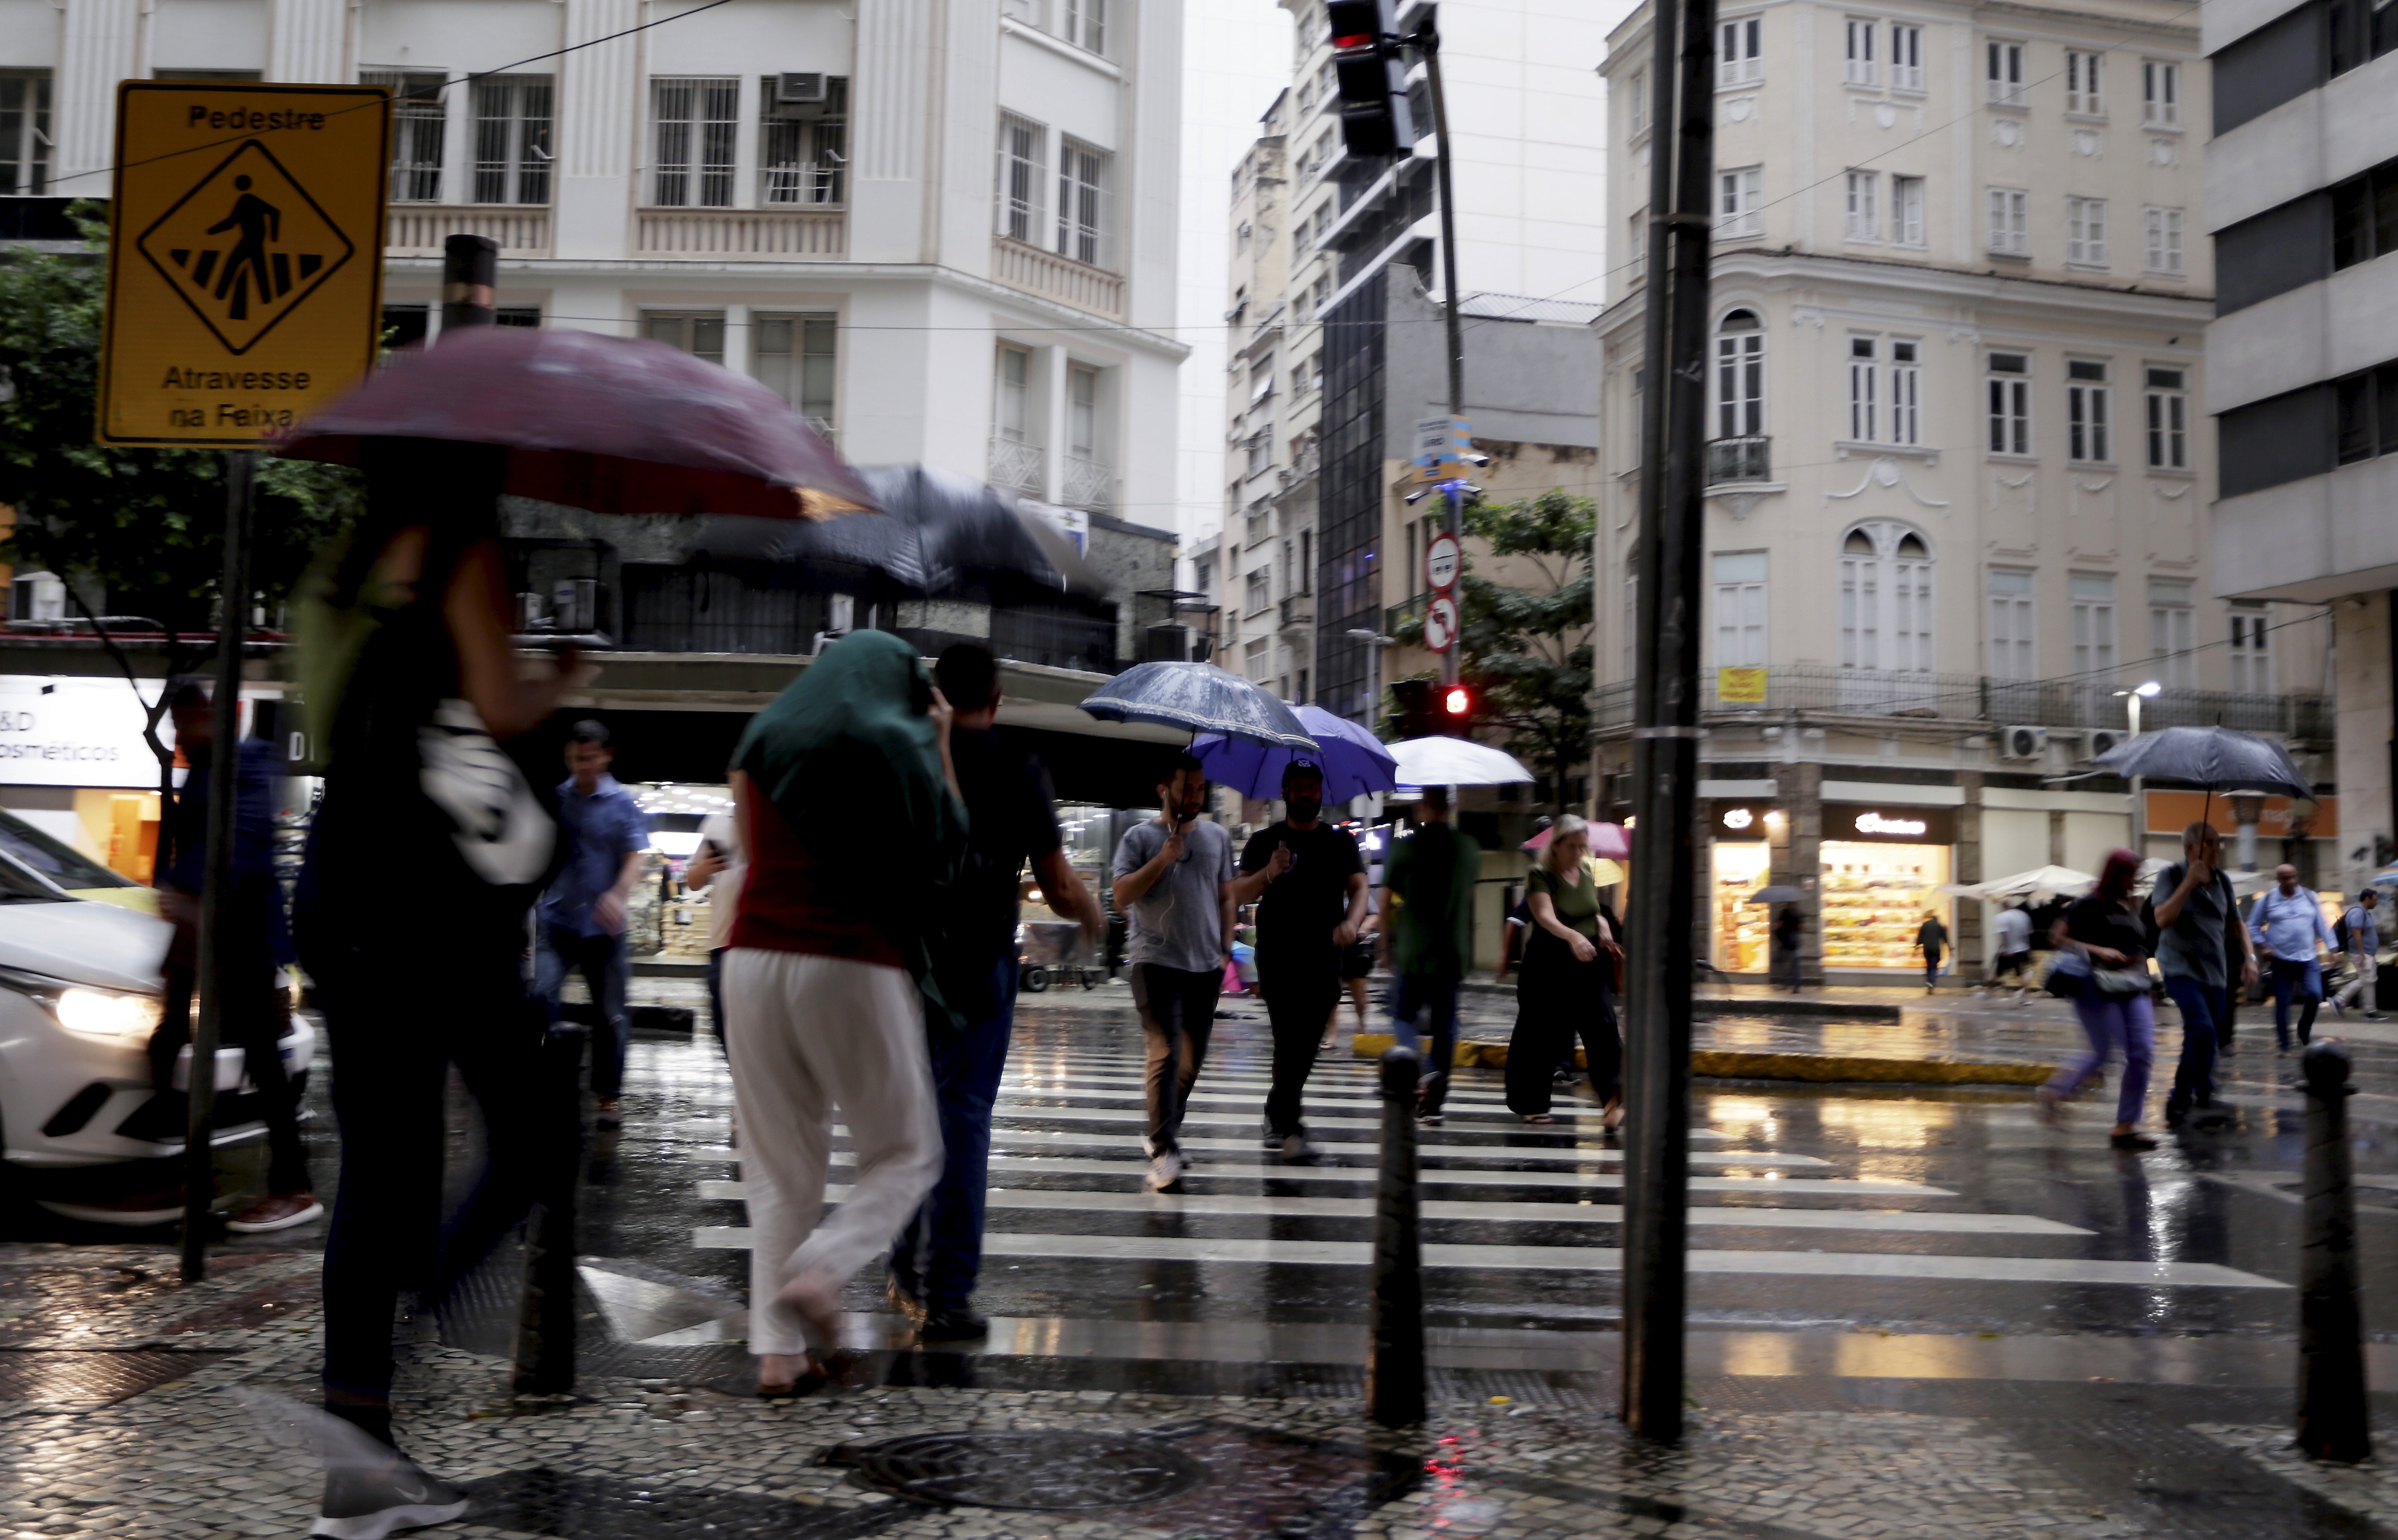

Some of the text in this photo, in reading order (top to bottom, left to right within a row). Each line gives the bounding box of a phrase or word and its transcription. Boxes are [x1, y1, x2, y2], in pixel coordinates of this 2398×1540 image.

[188, 105, 325, 130] Pedestre
[161, 365, 310, 390] Atravesse
[170, 403, 293, 427] na Faixa
